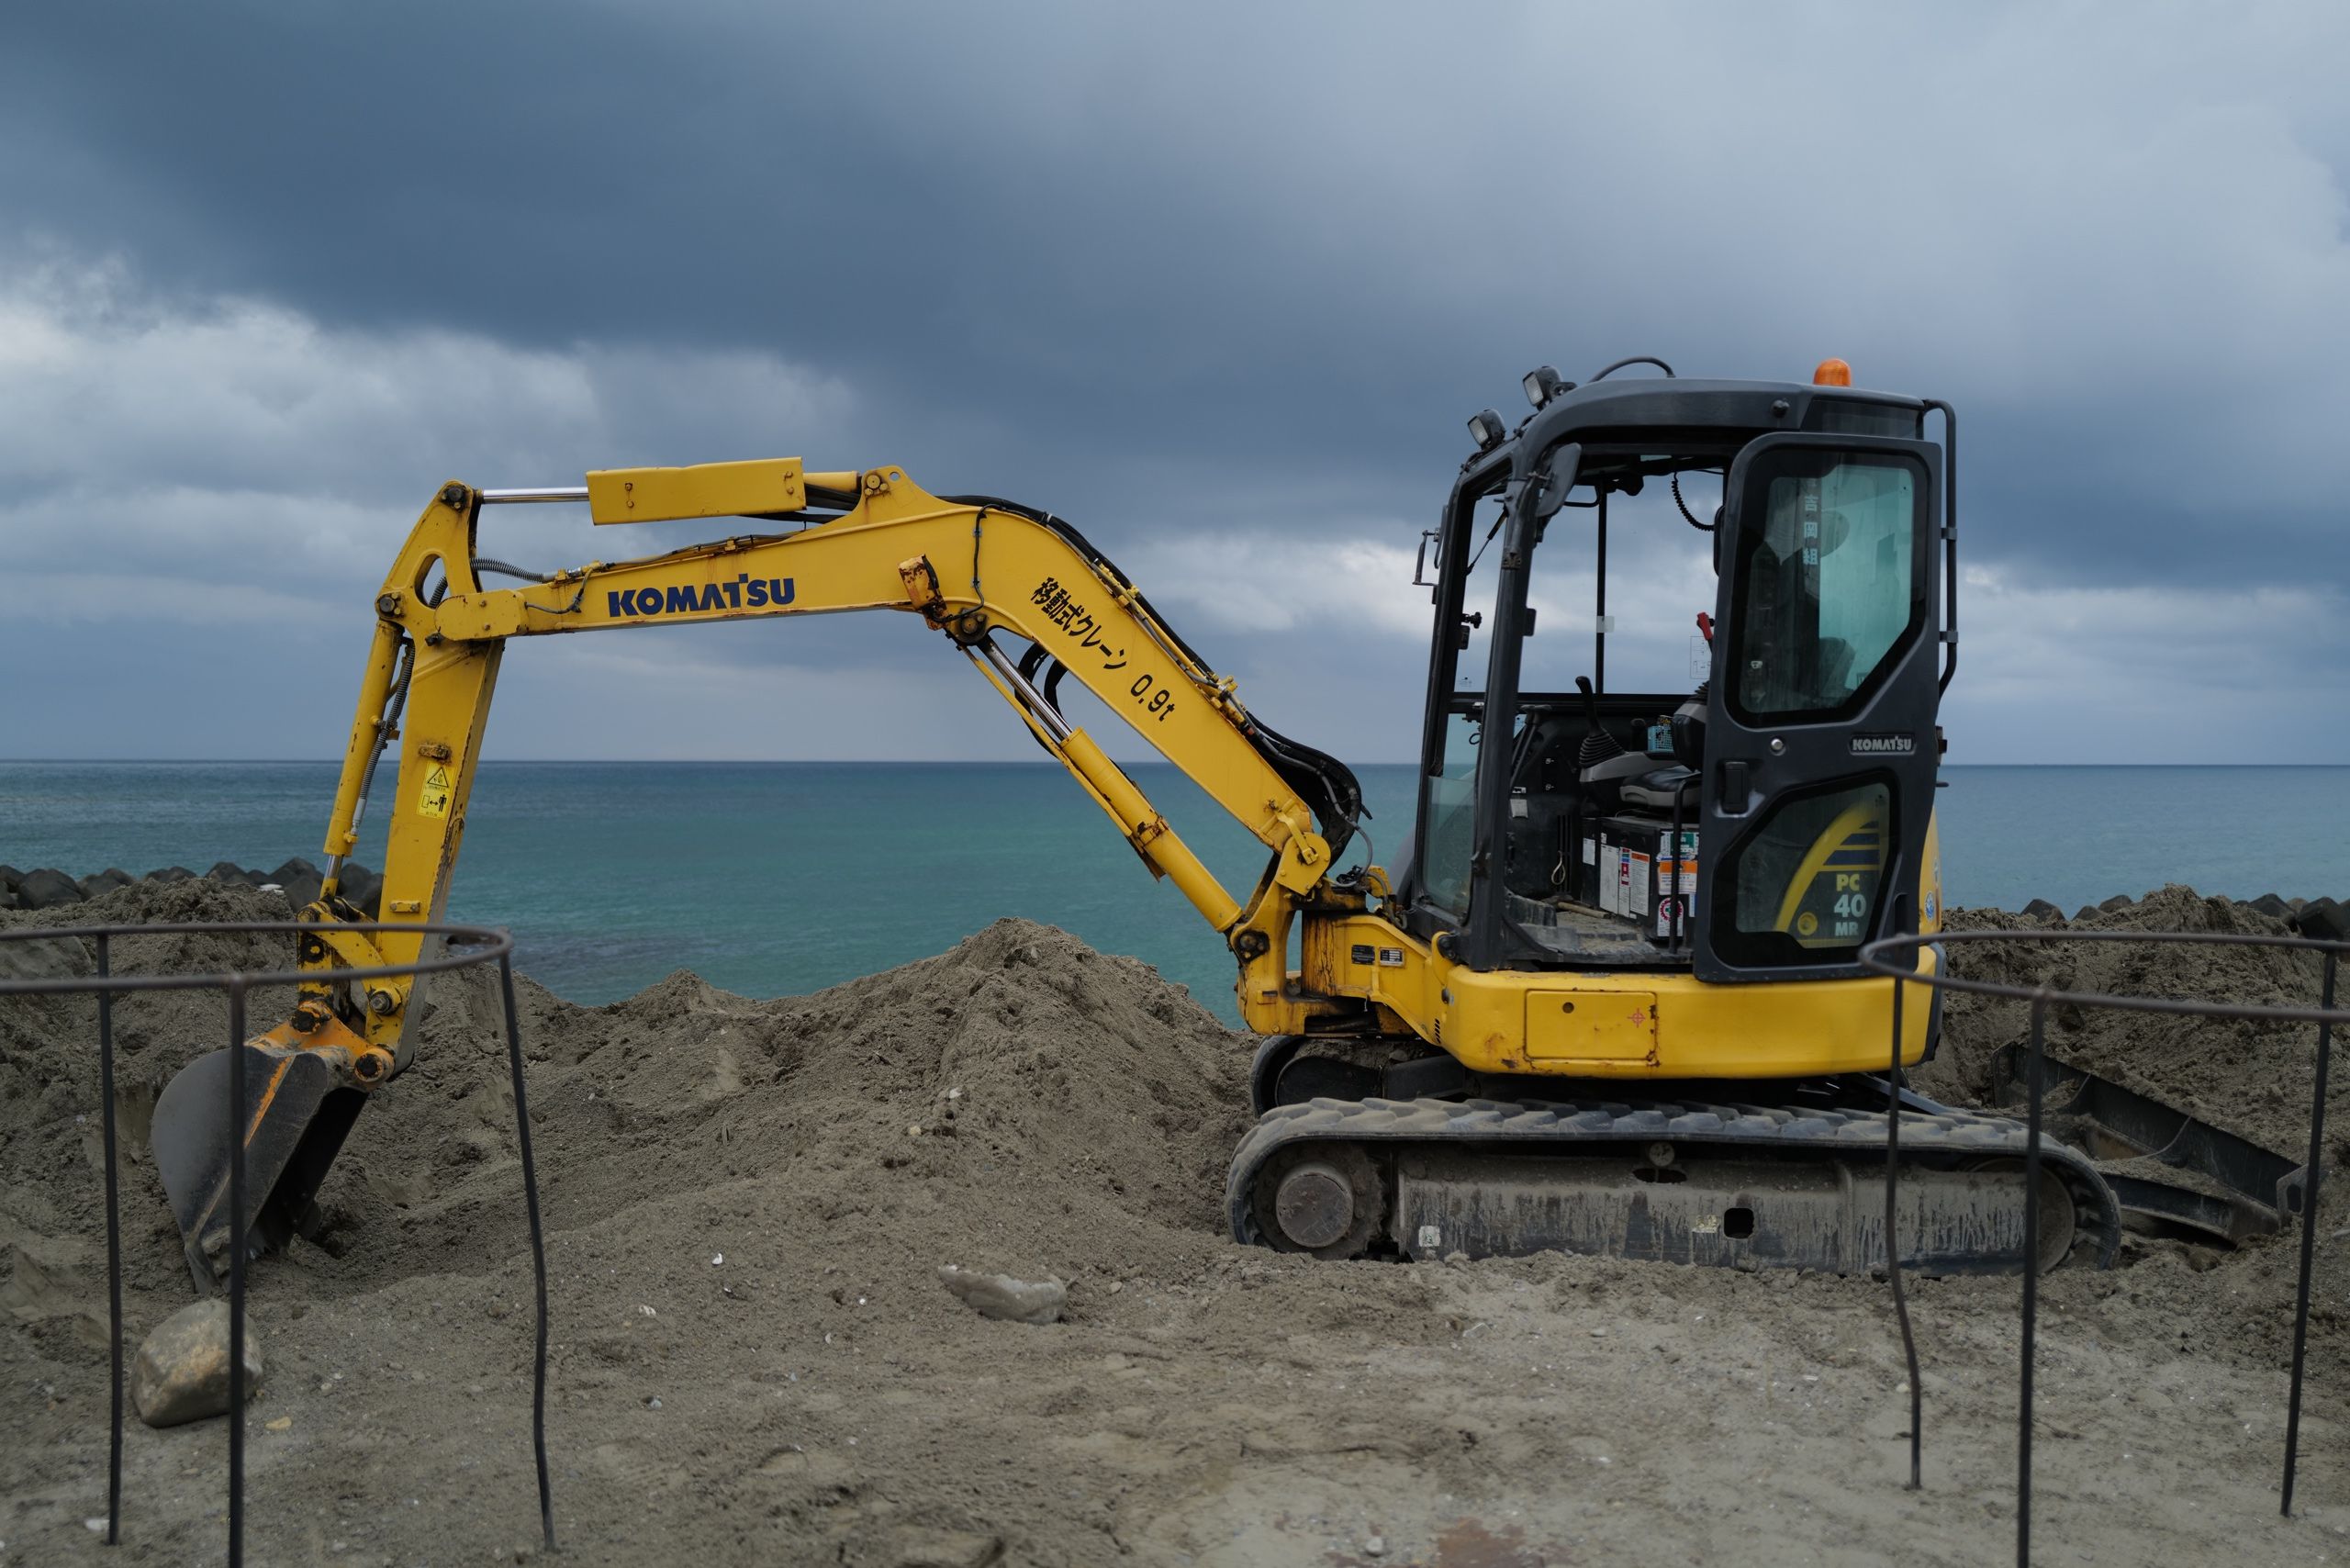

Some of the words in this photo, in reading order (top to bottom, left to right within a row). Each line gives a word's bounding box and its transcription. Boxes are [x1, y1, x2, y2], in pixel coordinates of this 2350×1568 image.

[608, 573, 795, 618] KOMATSU
[1030, 577, 1127, 670] 移動式クレーン
[1130, 674, 1176, 722] 0.9t
[1852, 735, 1912, 752] KOMATSU
[1836, 873, 1860, 892] PC
[1833, 894, 1866, 918] 40
[1835, 922, 1859, 936] MR
